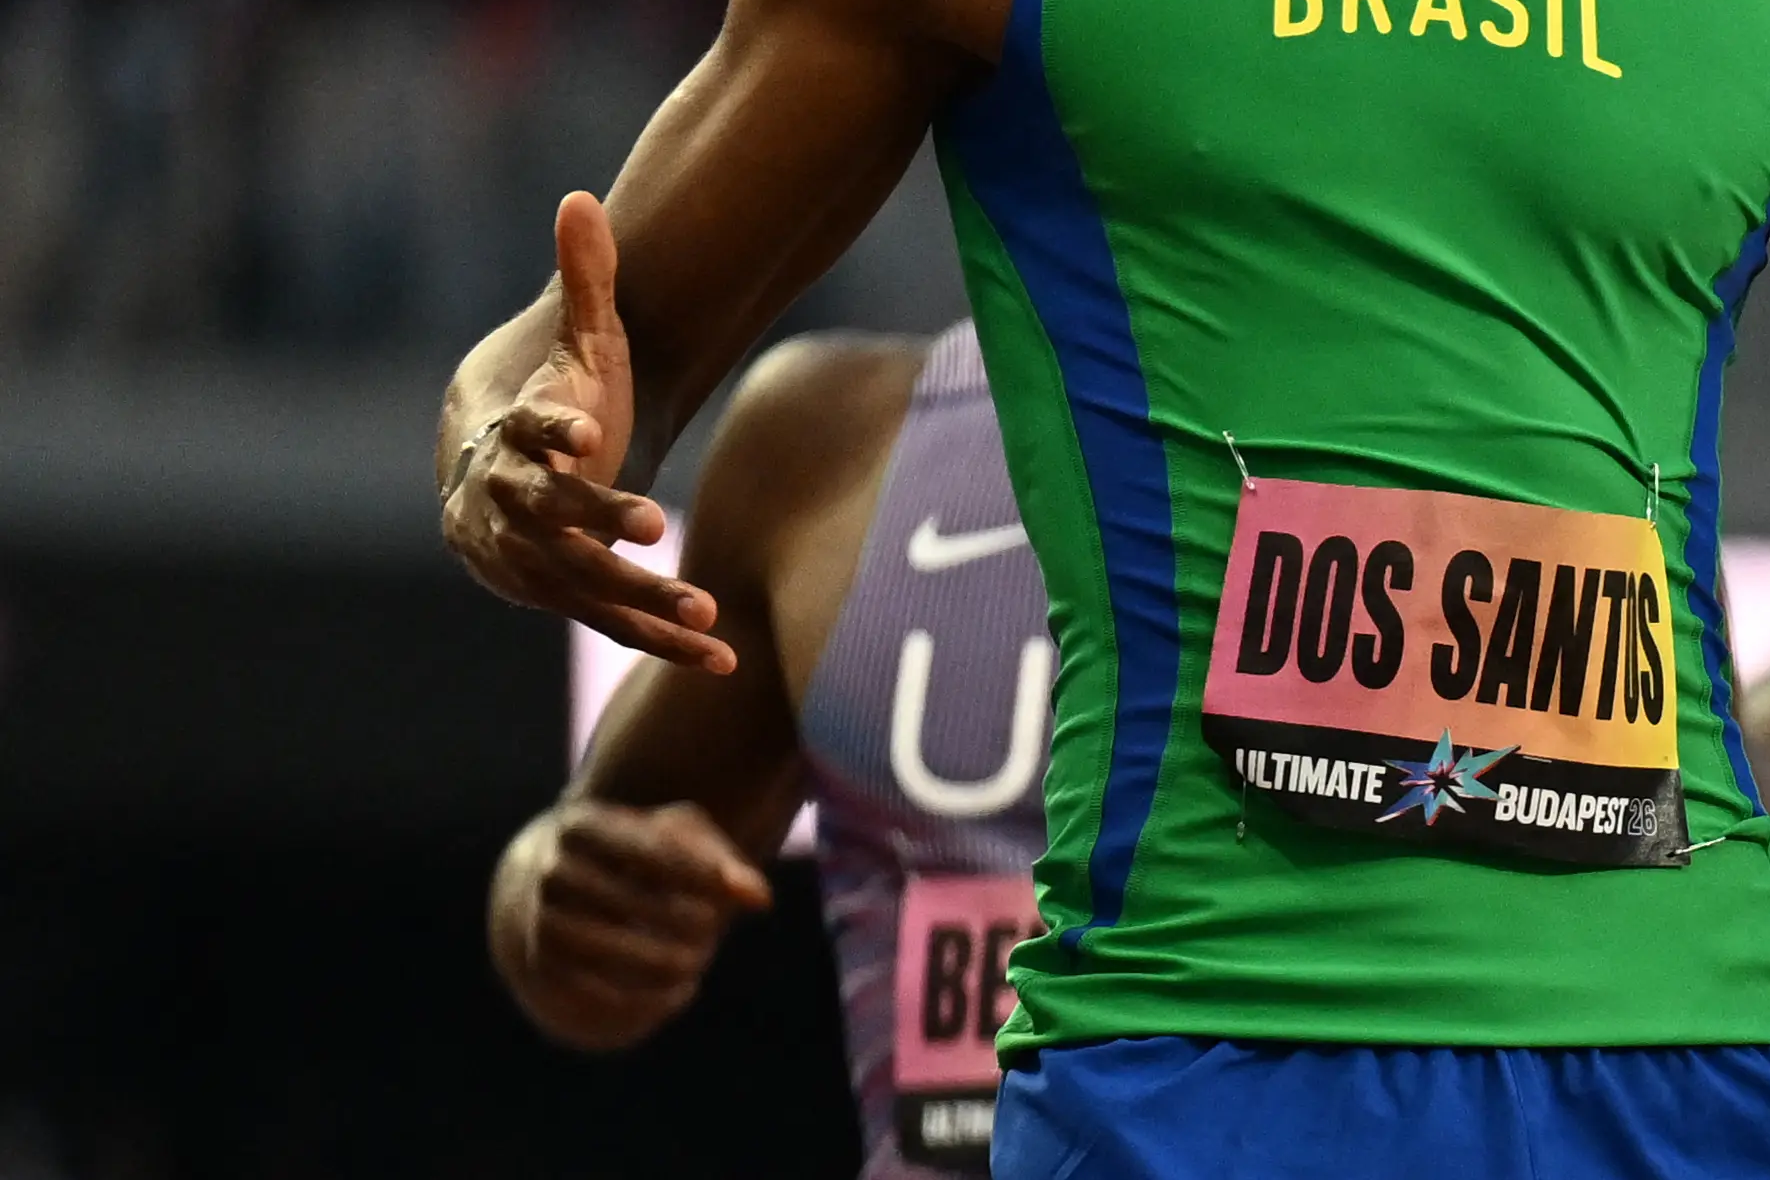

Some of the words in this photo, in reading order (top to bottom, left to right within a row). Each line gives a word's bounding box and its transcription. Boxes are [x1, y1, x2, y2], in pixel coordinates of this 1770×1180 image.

[1235, 531, 1414, 689] DOS
[1430, 549, 1663, 726] SANTOS
[1235, 748, 1387, 804] ULTIMATE
[923, 925, 1046, 1042] BE
